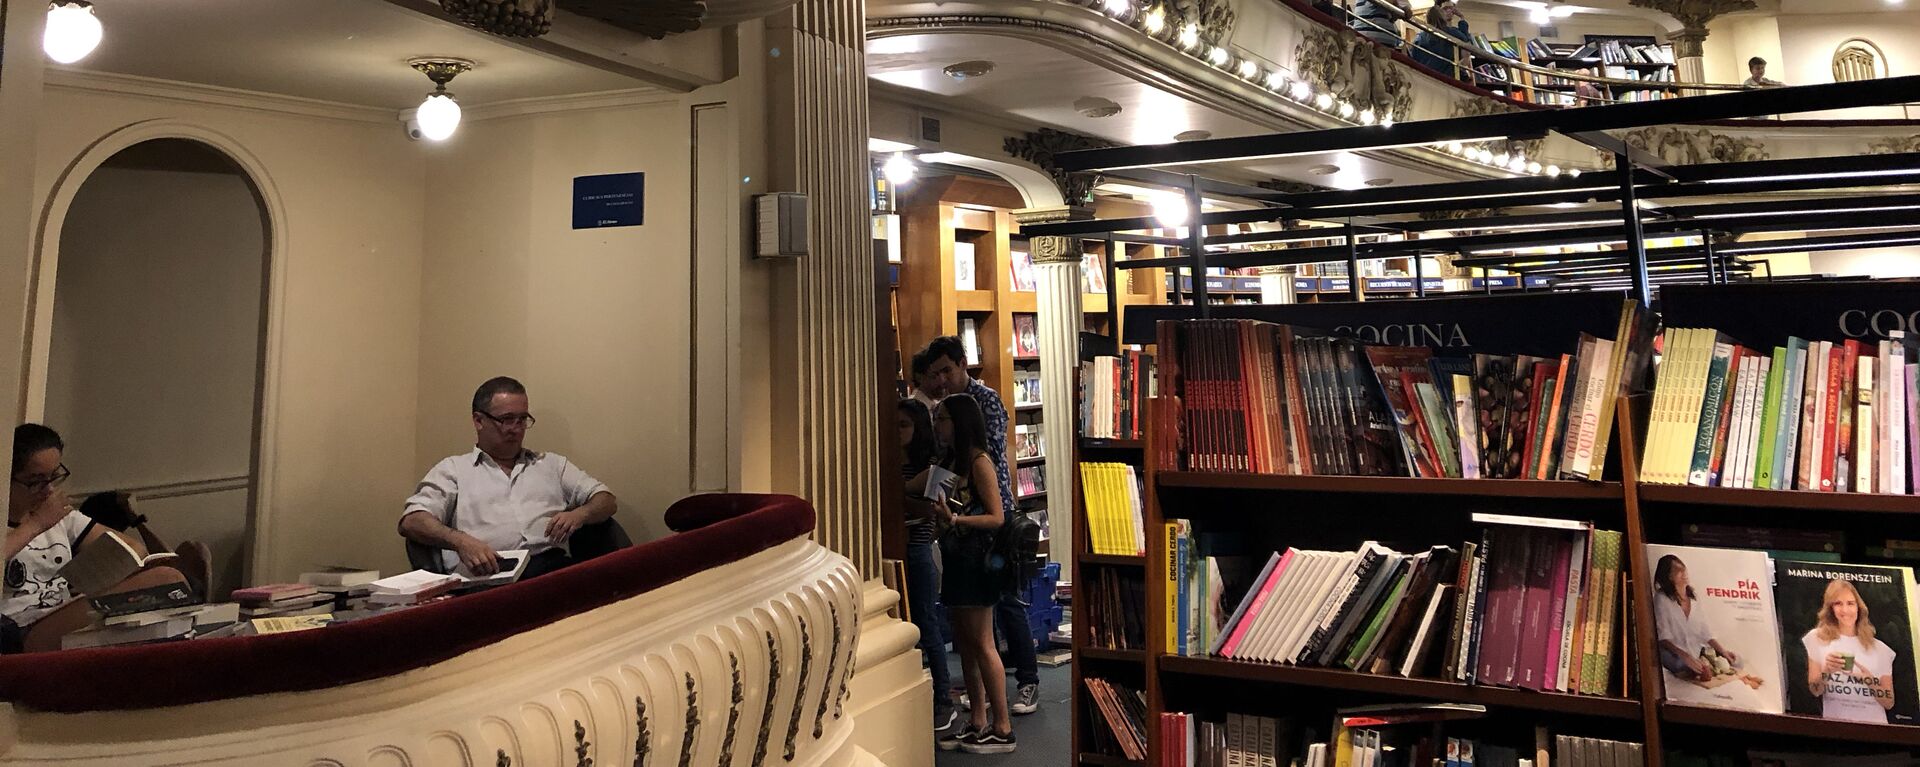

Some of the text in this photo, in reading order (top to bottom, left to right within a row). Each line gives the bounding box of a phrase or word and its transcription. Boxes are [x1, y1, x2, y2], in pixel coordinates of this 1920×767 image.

[1578, 413, 1597, 458] CERDO
[1788, 568, 1892, 584] MARINA BORENSZTEIN
[1738, 579, 1759, 590] PÍA
[1706, 587, 1761, 600] FENDRIK
[1847, 674, 1880, 686] AMOR
[1823, 684, 1852, 695] JUGO
[1854, 686, 1892, 699] VERDE
